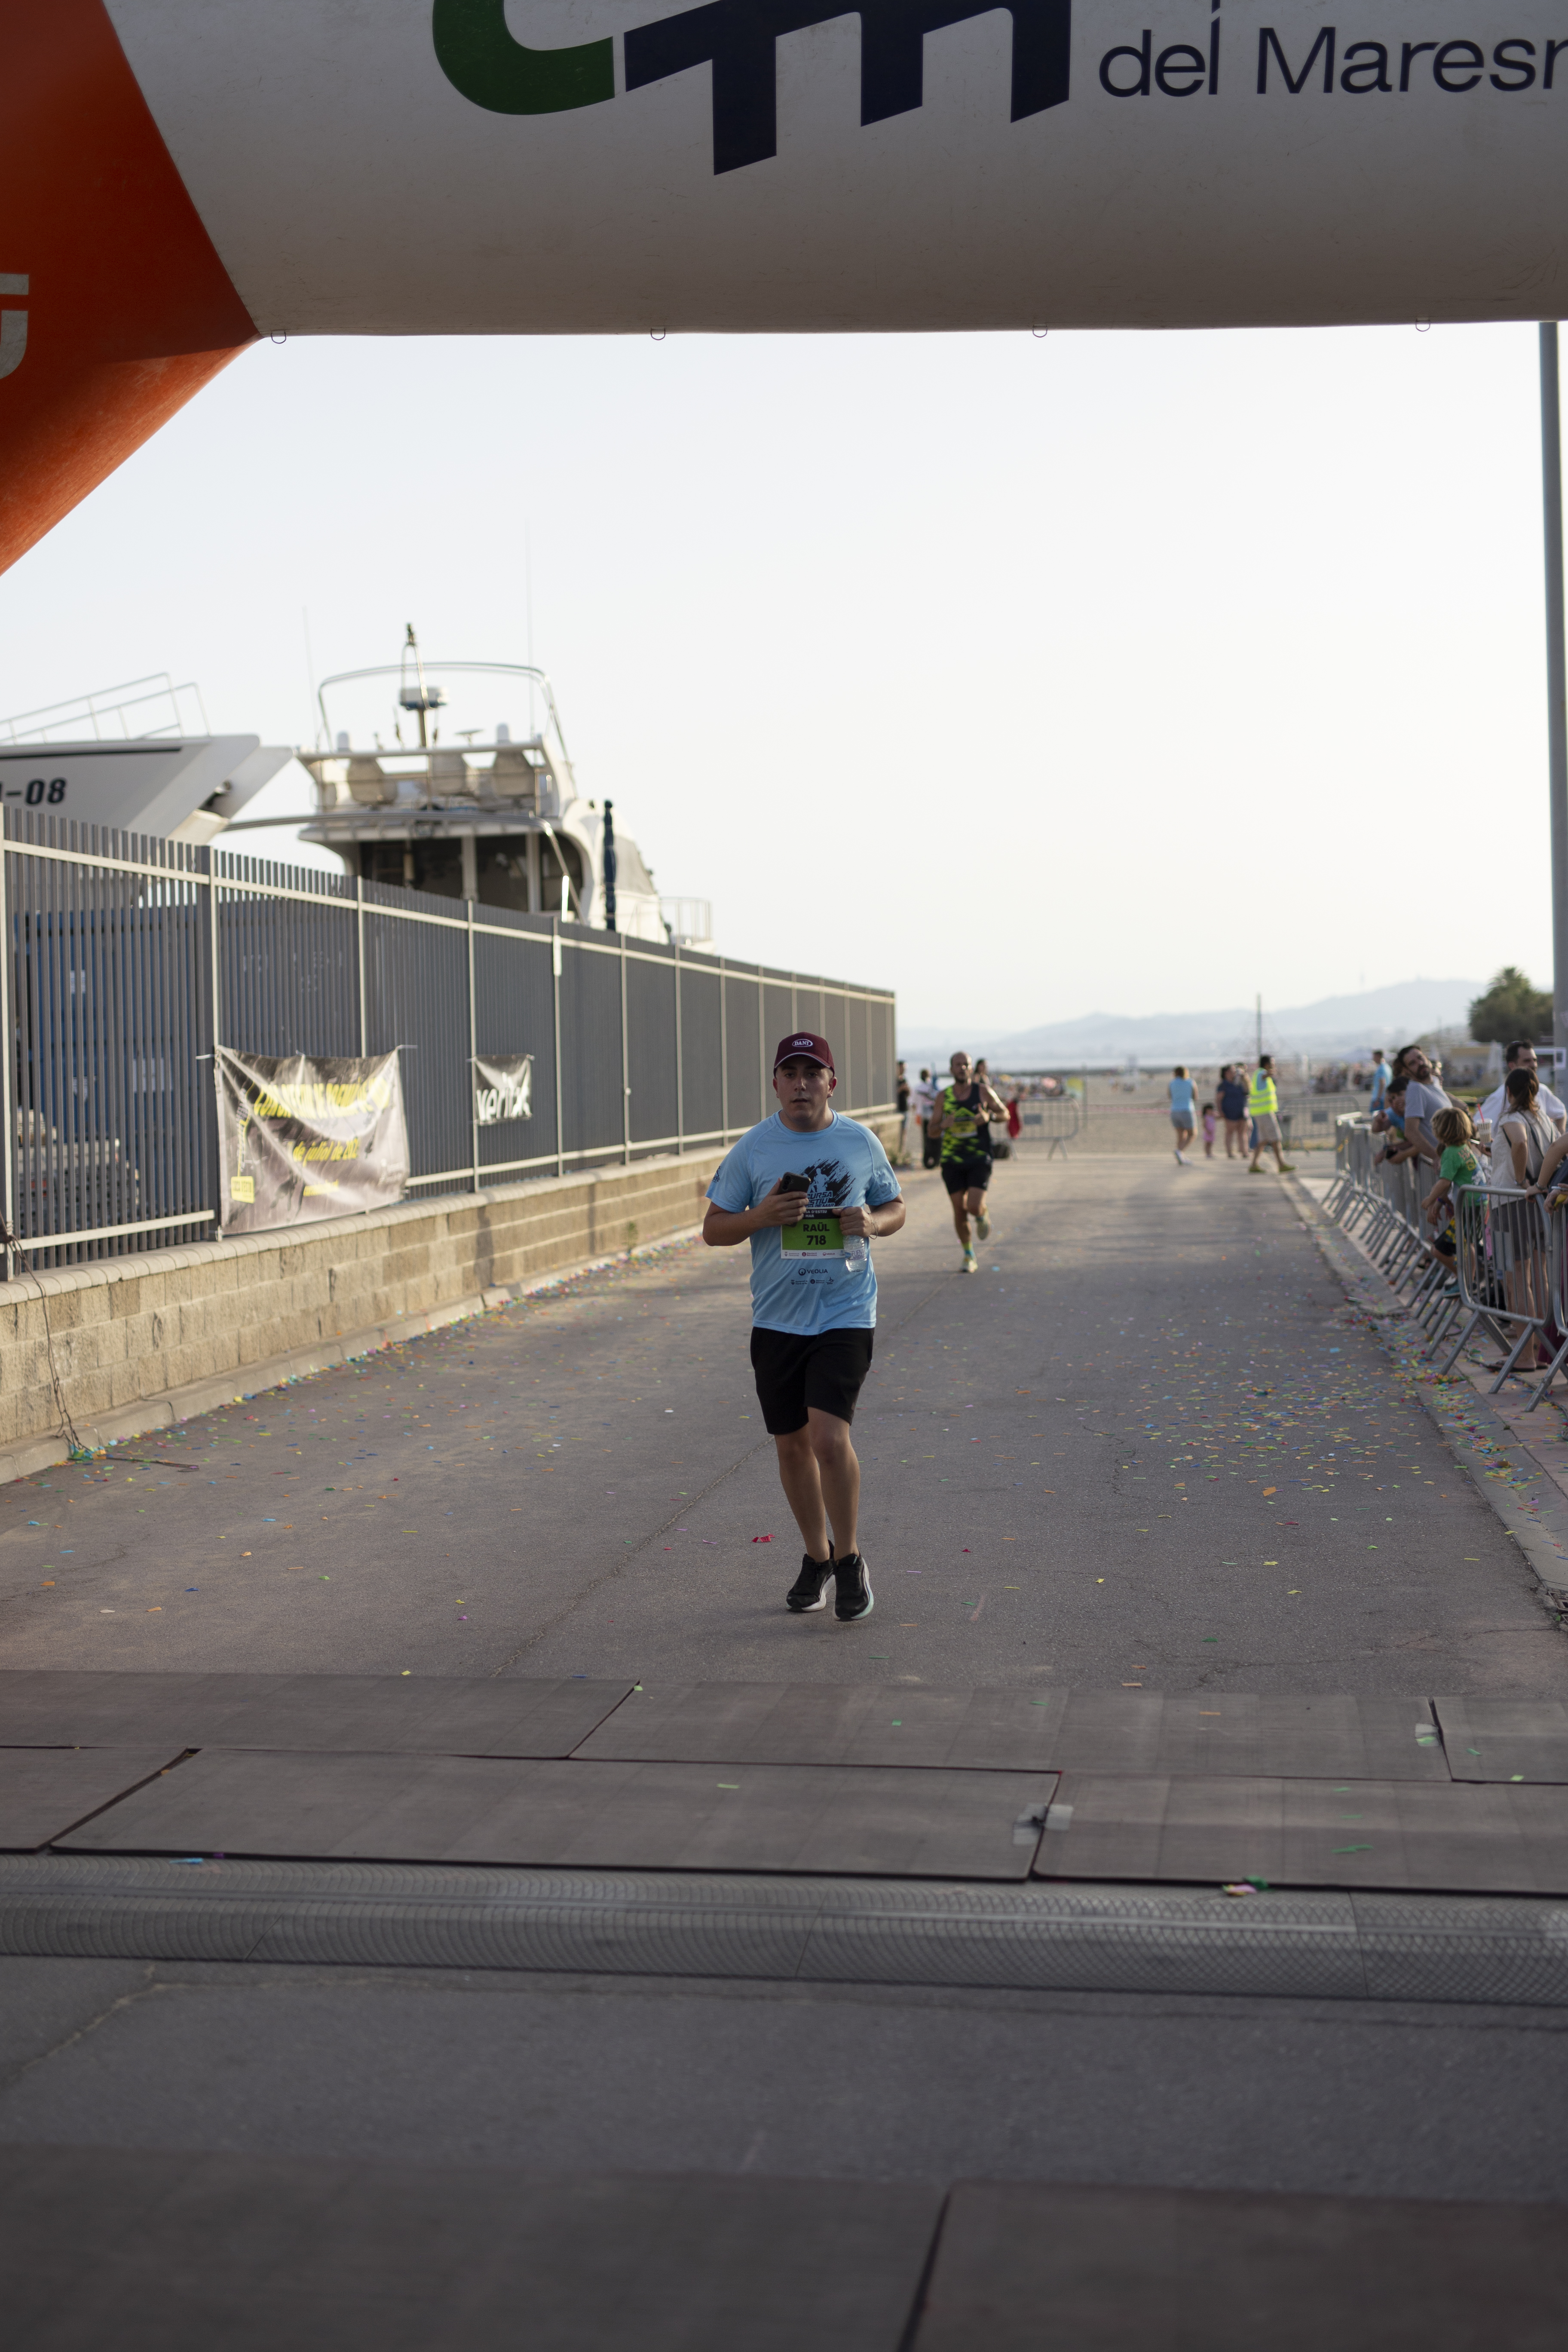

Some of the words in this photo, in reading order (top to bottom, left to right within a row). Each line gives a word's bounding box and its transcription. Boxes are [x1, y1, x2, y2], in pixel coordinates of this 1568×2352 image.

[1099, 15, 1221, 97] del
[0, 777, 67, 805] -08
[303, 1140, 334, 1167] juliol
[330, 1140, 343, 1161] de
[803, 1222, 830, 1232] RAÜL
[806, 1235, 826, 1245] 718
